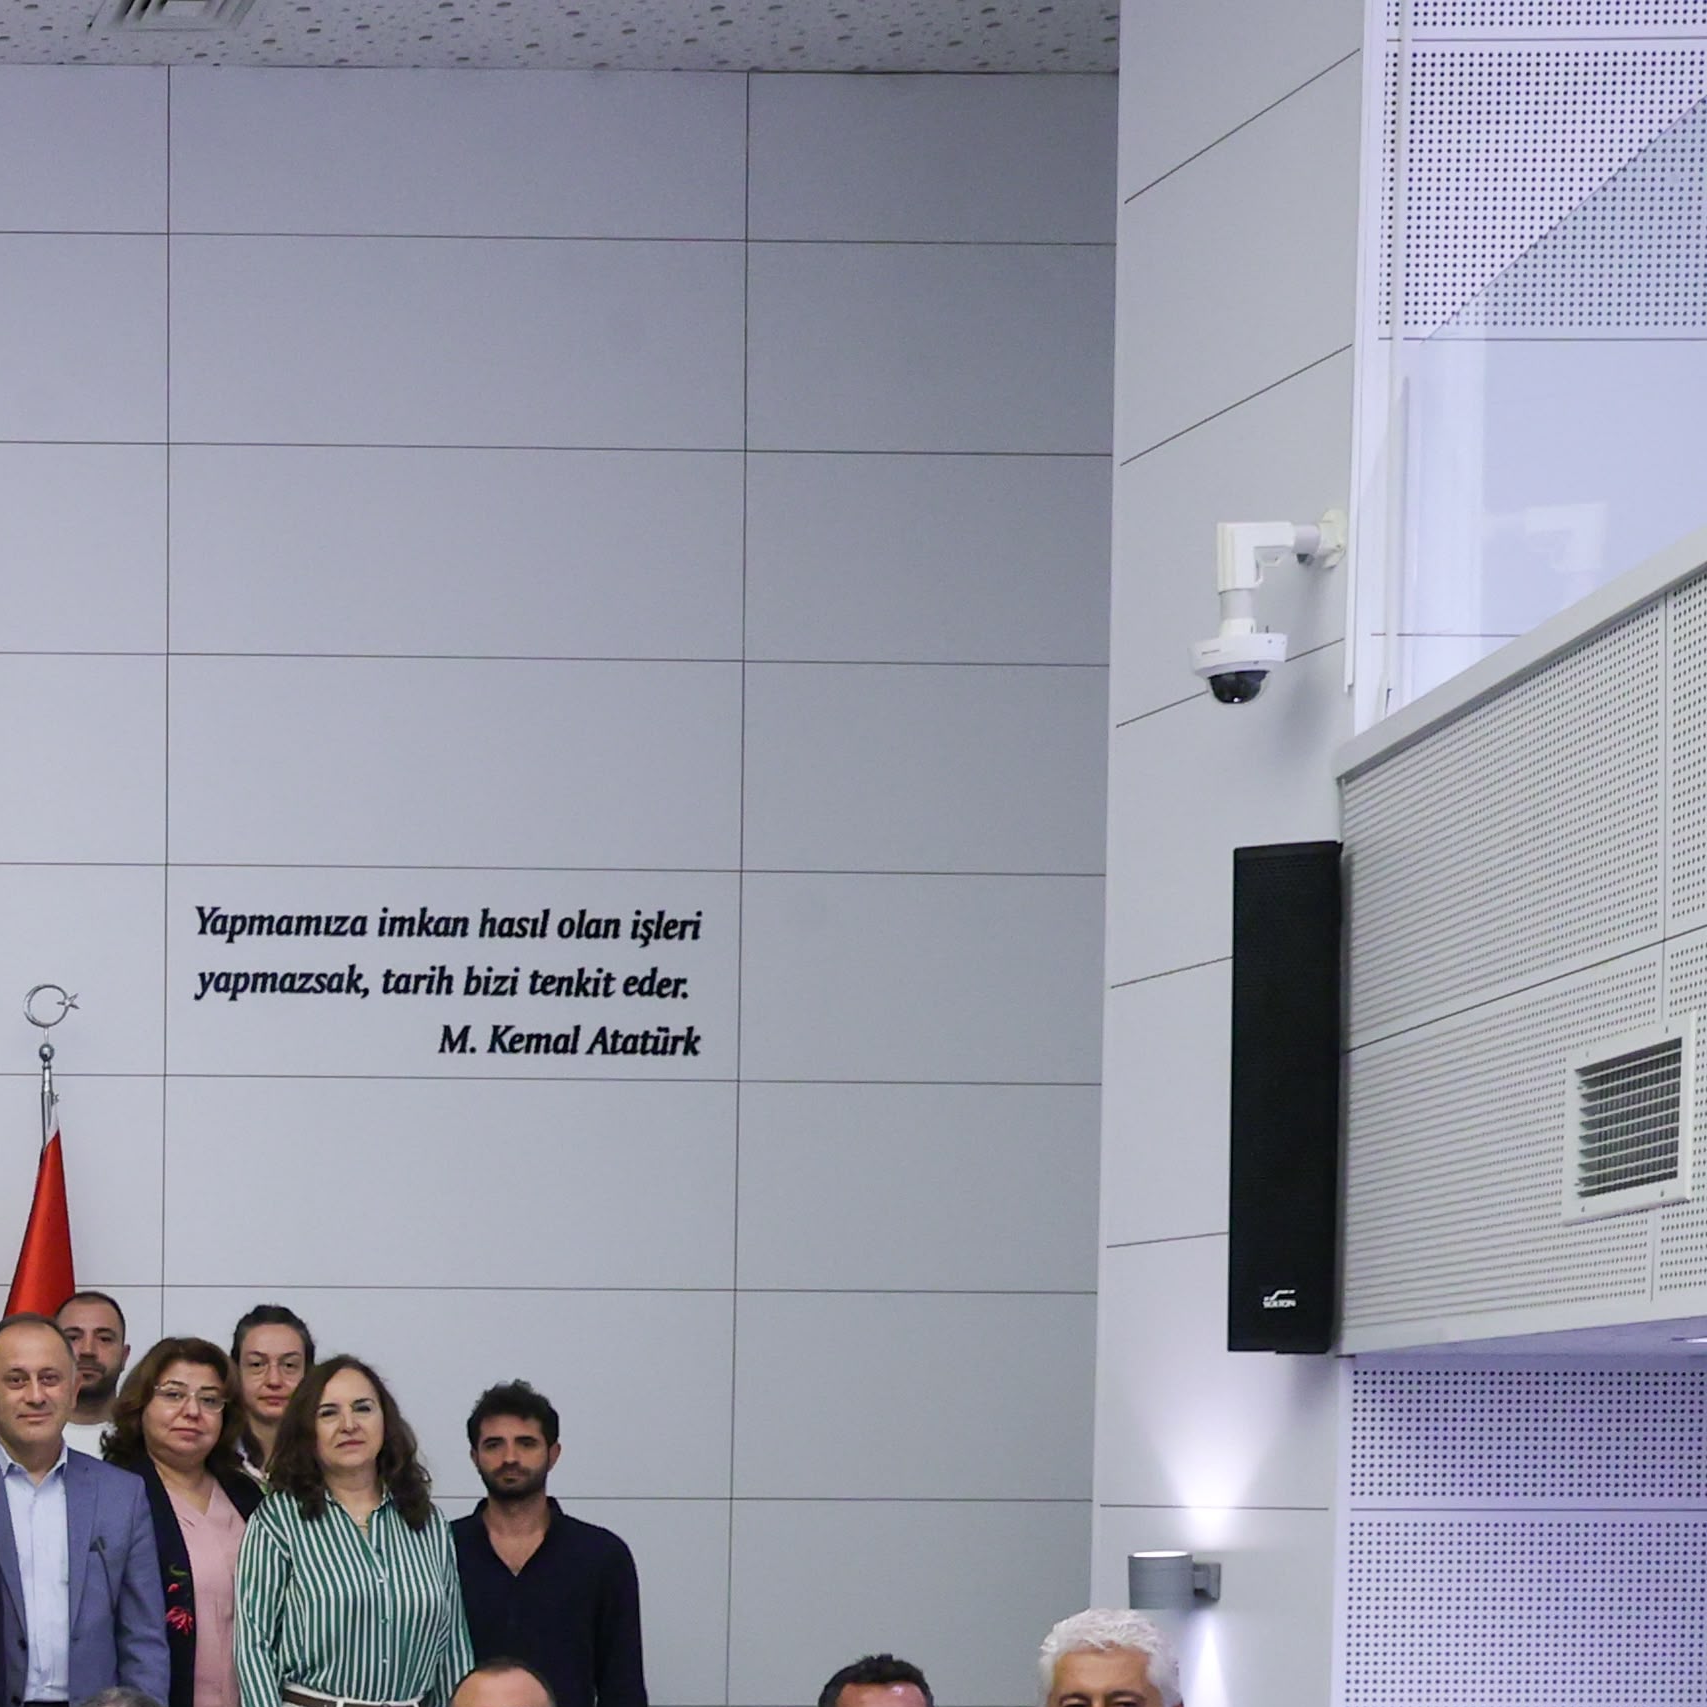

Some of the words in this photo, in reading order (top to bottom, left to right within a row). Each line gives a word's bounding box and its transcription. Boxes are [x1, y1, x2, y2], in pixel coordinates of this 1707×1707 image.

[195, 906, 368, 943] Yapmamıza
[378, 907, 469, 938] imkan
[478, 908, 548, 939] hasıl
[558, 910, 620, 940] olan
[630, 909, 702, 947] işleri
[195, 964, 370, 1000] yapmazsak,
[382, 965, 454, 996] tarih
[464, 966, 520, 996] bizi
[529, 967, 617, 998] tenkit
[623, 968, 689, 999] eder.
[439, 1025, 477, 1054] M.
[488, 1025, 580, 1054] Kemal
[586, 1025, 701, 1056] Atatürk
